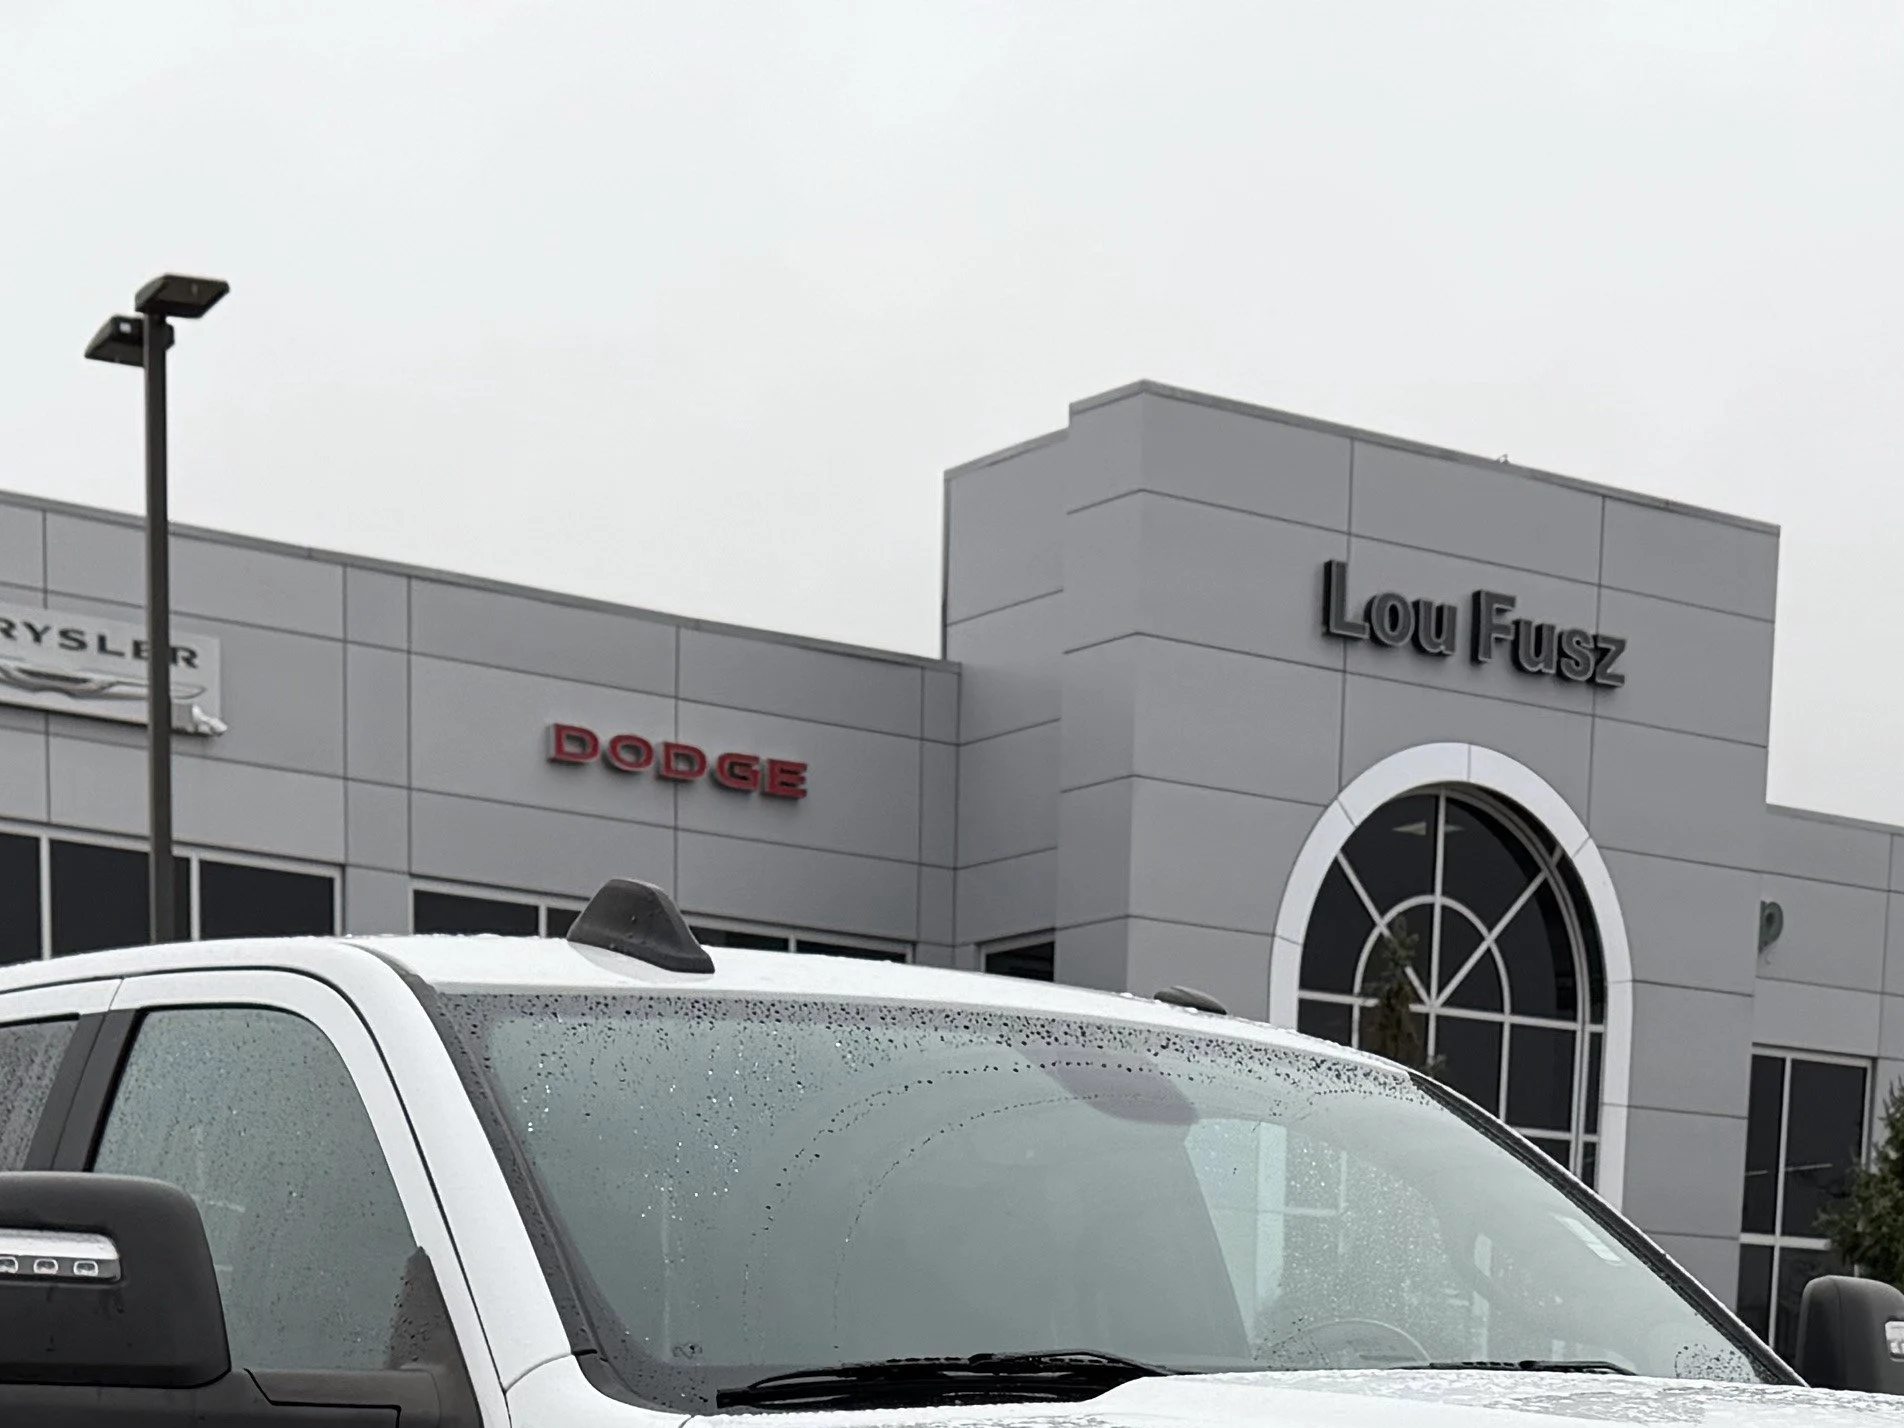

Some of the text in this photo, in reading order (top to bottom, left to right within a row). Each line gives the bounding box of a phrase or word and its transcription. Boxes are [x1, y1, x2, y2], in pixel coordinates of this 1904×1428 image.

[1322, 559, 1627, 688] Lou Fusz
[548, 723, 808, 799] DODGE
